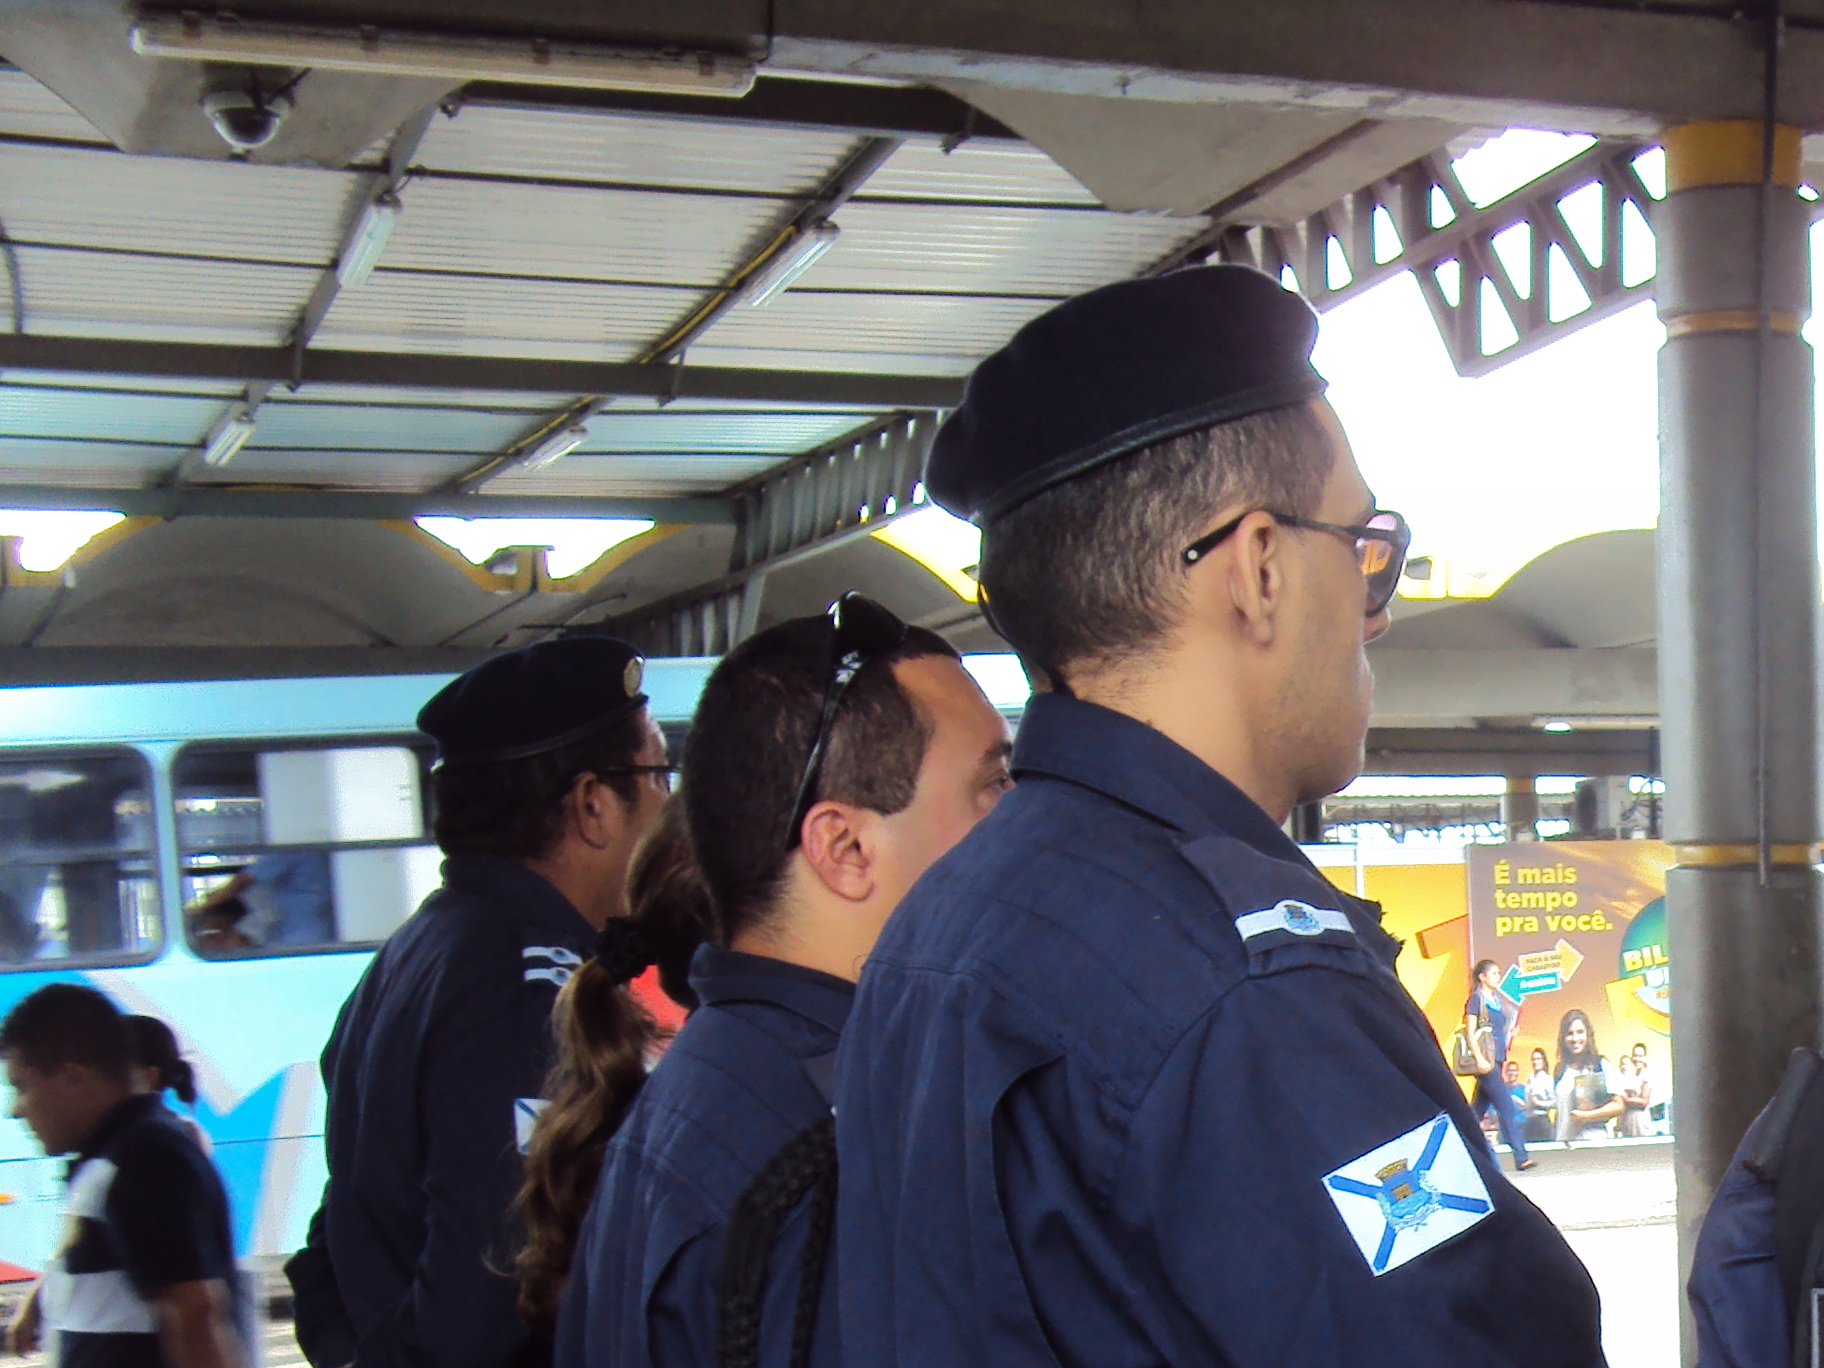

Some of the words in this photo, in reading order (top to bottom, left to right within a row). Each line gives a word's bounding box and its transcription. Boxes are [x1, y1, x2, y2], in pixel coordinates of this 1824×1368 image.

[1493, 858, 1511, 885] É
[1517, 863, 1578, 885] mais
[1494, 888, 1579, 912] tempo
[1495, 915, 1539, 937] pra
[1544, 909, 1614, 932] você.
